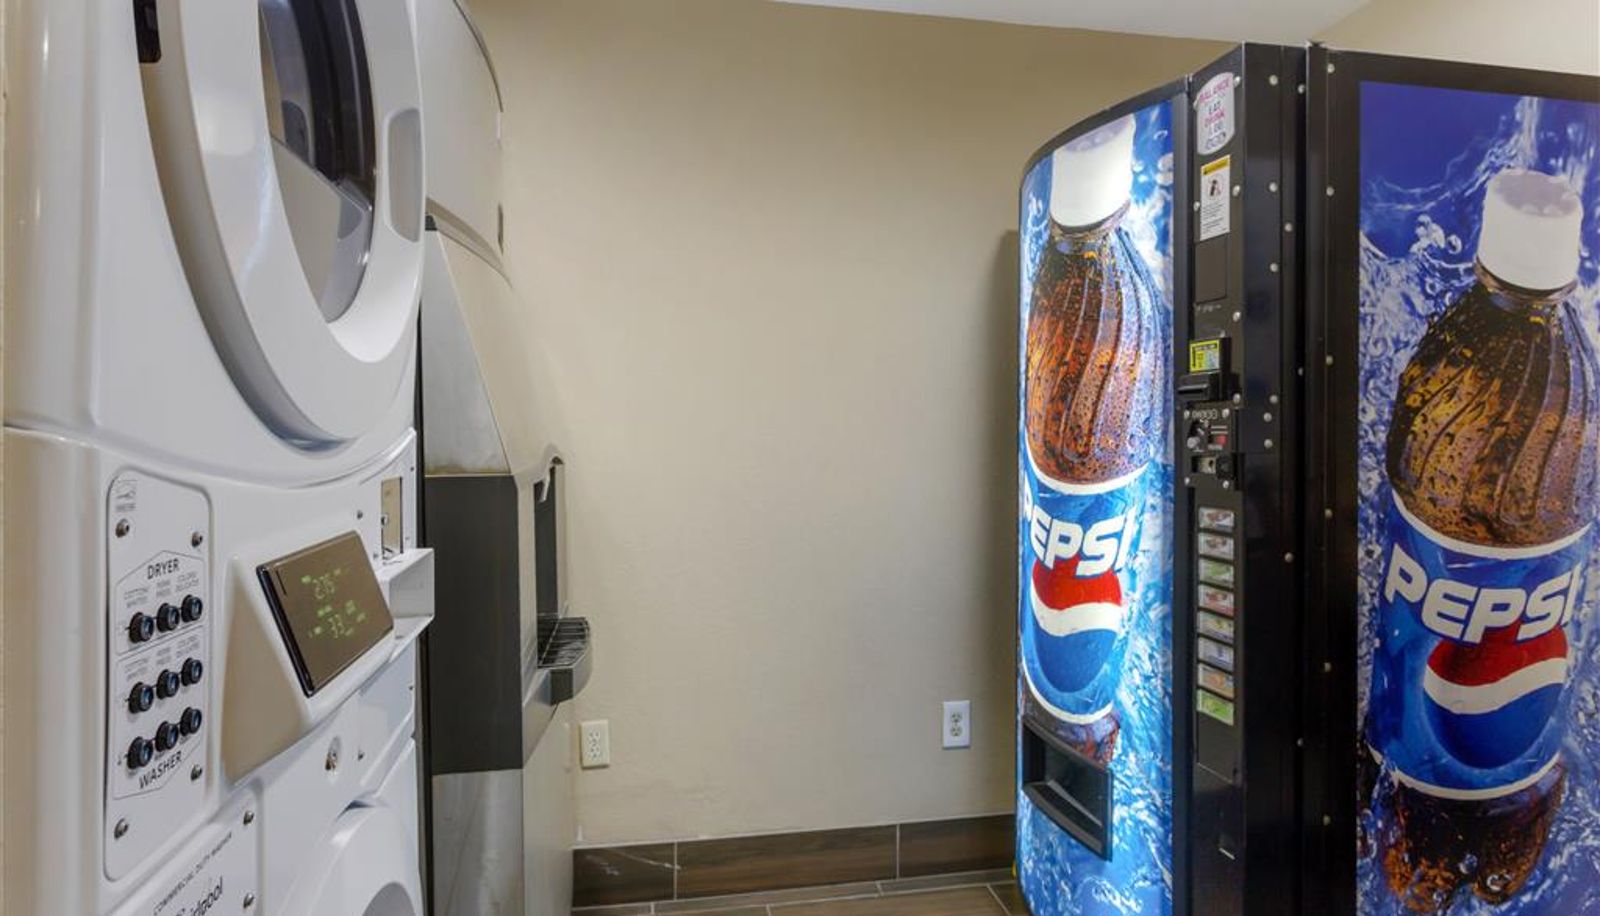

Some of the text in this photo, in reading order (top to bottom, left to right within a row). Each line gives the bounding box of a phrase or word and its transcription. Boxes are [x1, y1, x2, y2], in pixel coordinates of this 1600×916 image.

[1024, 470, 1137, 577] PEPSI
[147, 558, 180, 580] DRYER
[1384, 543, 1583, 645] PEPSI
[138, 750, 183, 789] WASHER
